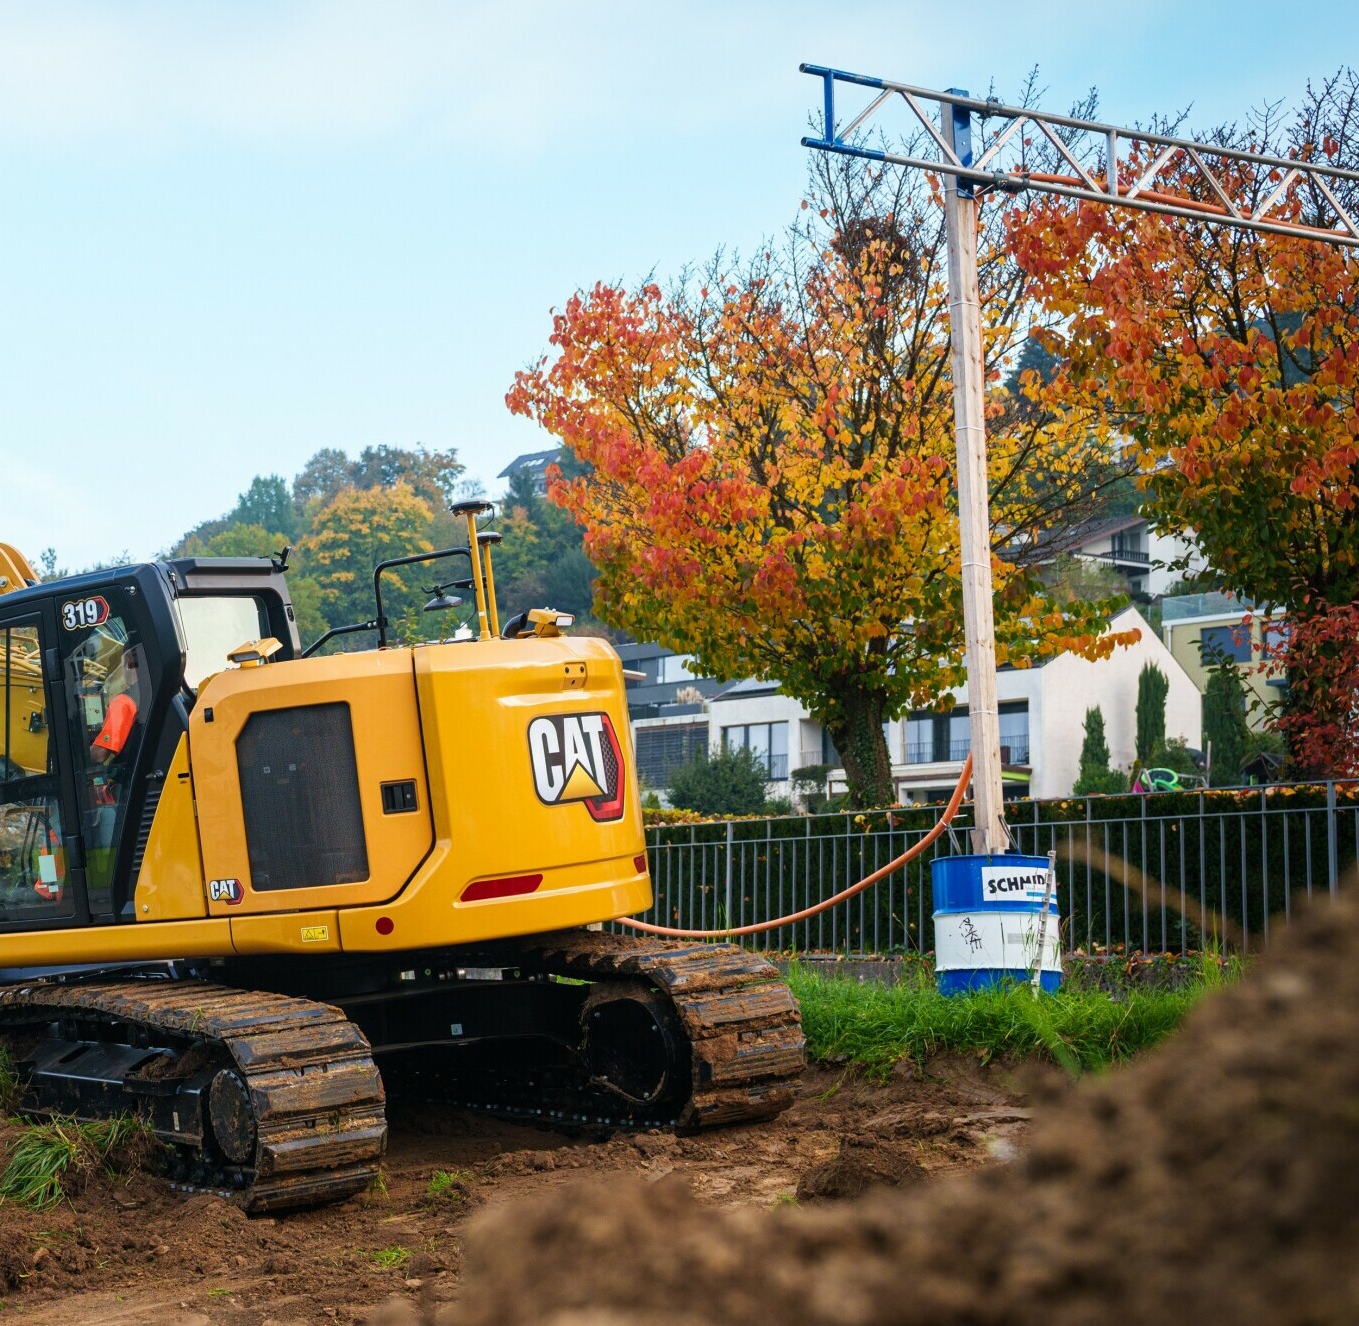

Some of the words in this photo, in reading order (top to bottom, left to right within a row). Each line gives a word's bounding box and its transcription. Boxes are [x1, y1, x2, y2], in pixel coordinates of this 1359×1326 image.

[64, 599, 98, 628] 319
[529, 715, 609, 802] CAT
[210, 879, 236, 901] CAT
